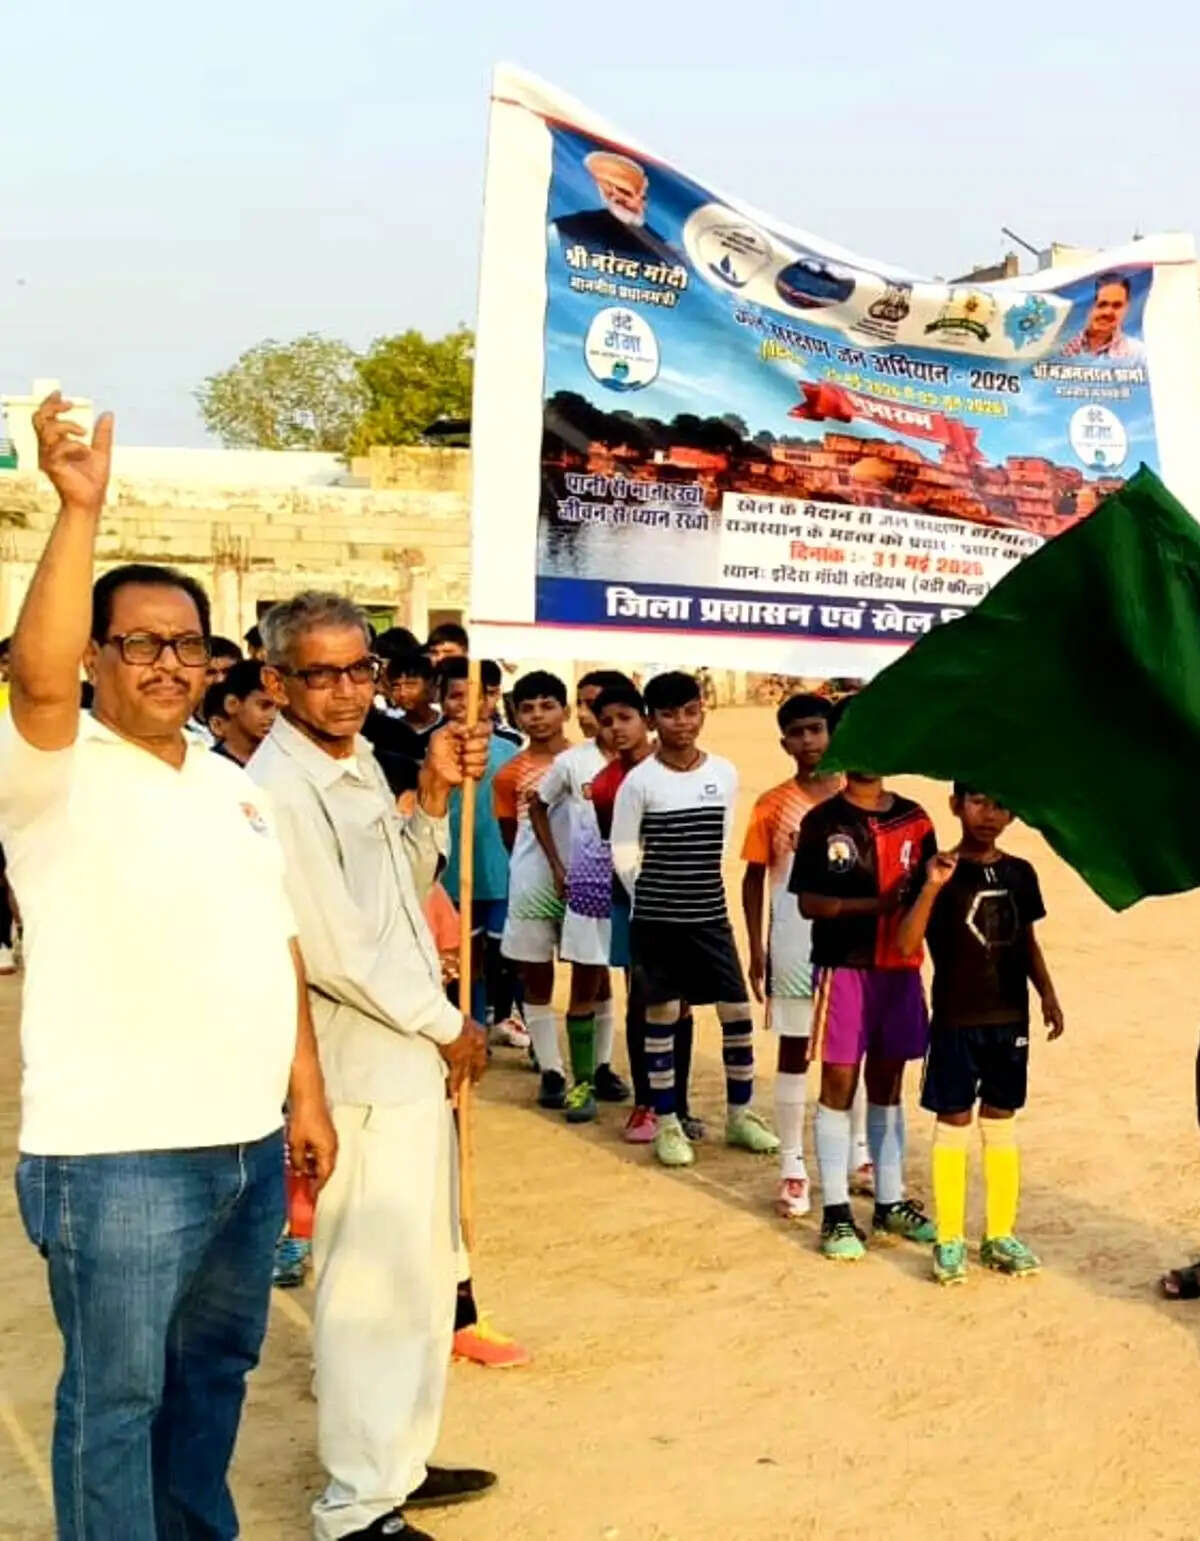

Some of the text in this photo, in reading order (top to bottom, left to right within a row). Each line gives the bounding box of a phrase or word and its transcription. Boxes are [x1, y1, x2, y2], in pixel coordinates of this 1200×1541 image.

[565, 244, 589, 270] श्री
[642, 261, 688, 291] मोदी
[870, 351, 949, 385] अभियान
[970, 368, 1022, 394] 2026
[564, 472, 607, 496] पानी
[557, 496, 608, 522] जीवन
[632, 506, 670, 528] ध्यान
[737, 498, 774, 515] खेल
[726, 518, 802, 537] राजस्थान
[790, 539, 844, 563] दिनांक
[872, 551, 897, 568] 31
[904, 551, 929, 574] मई
[936, 557, 984, 576] 2026
[606, 585, 692, 619] जिला
[701, 598, 813, 627] प्रशासन
[818, 601, 866, 630] एवं
[872, 604, 934, 633] खेल
